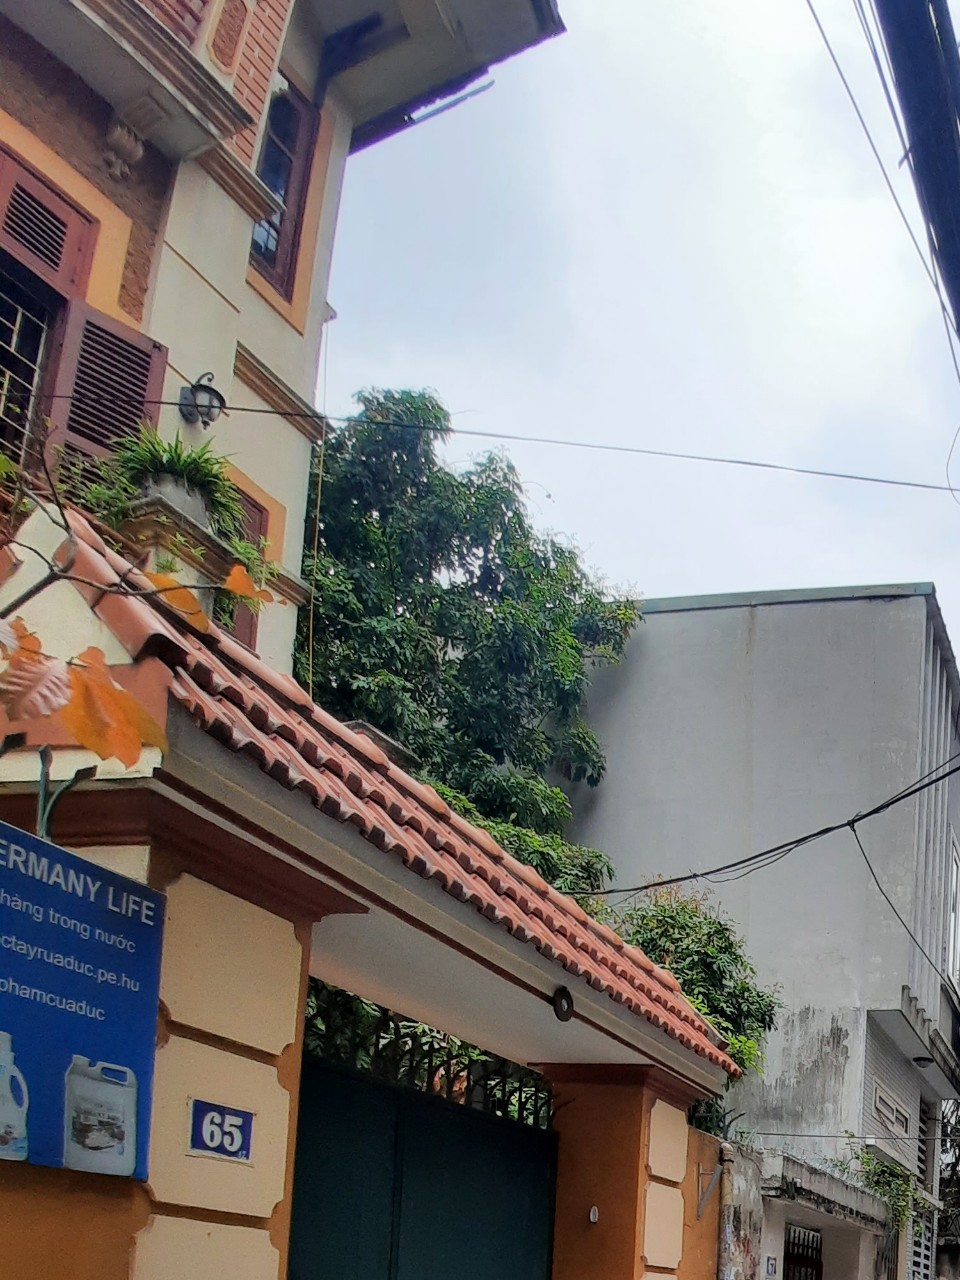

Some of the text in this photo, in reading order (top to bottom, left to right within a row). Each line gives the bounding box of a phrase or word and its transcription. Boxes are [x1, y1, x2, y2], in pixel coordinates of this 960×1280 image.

[108, 886, 156, 927] LIFE
[49, 907, 92, 940] trong
[95, 928, 137, 954] nước
[0, 934, 140, 992] ctayruaduc.pe.hu
[202, 1111, 243, 1152] 65
